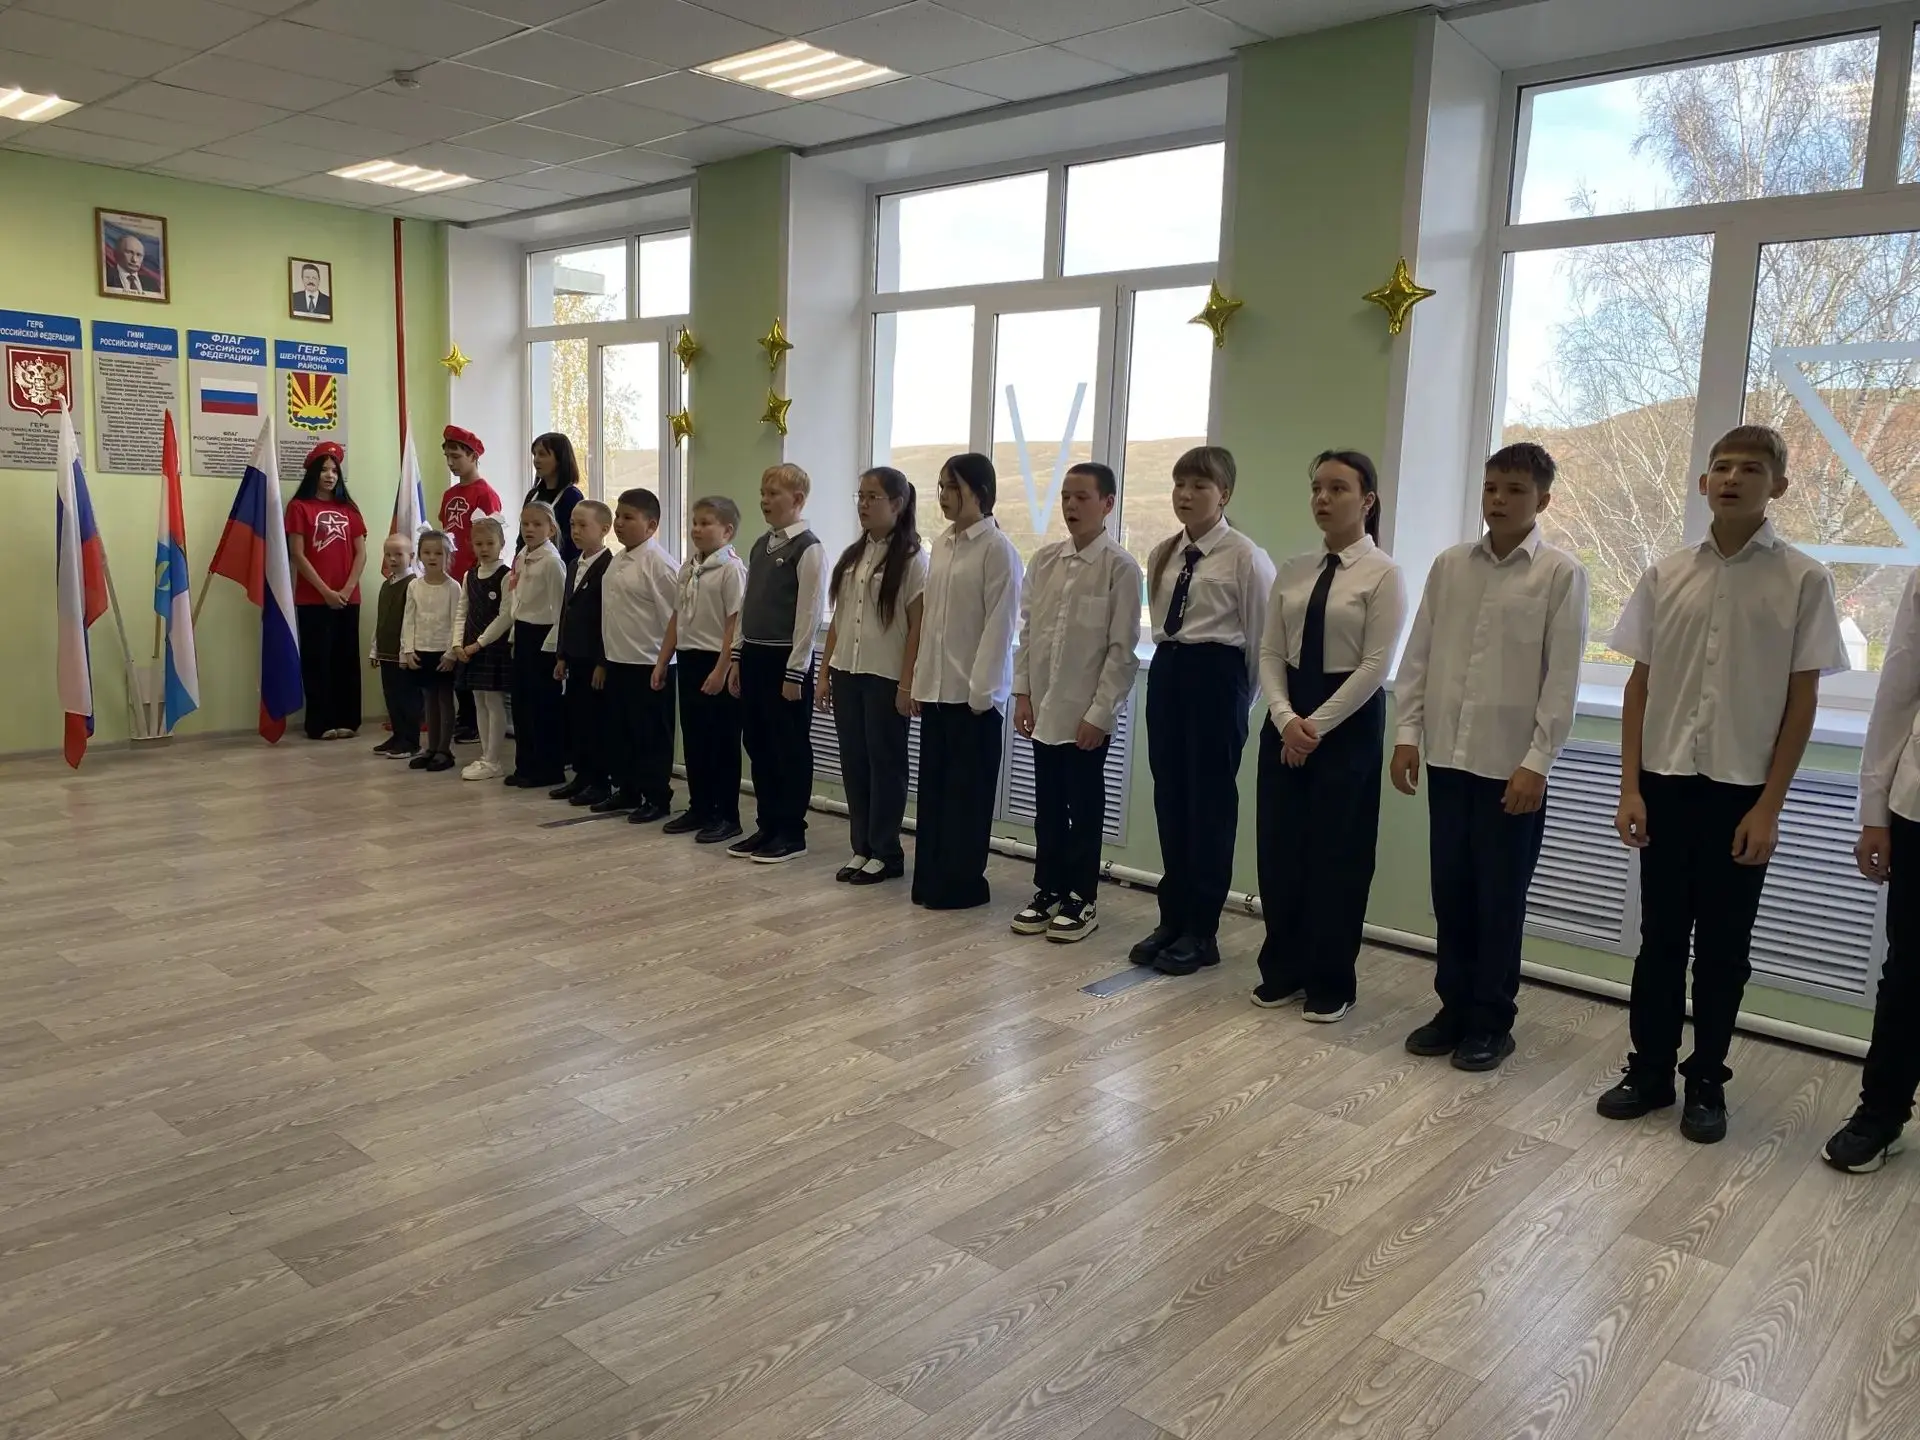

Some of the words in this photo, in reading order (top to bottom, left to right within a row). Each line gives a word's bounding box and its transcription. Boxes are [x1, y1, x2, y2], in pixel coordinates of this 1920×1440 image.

[26, 320, 44, 329] ГЕРБ
[40, 332, 76, 343] ФЕДЕРАЦИИ
[127, 330, 145, 339] ГИМН
[211, 334, 246, 345] ФЛАГ
[100, 337, 139, 349] РОССИЙСКОЙ
[140, 342, 173, 352] ФЕДЕРАЦИИ
[195, 342, 260, 356] РОССИЙСКОЙ
[298, 344, 328, 355] ГЕРБ
[200, 350, 253, 362] ФЕДЕРАЦИИ
[280, 352, 345, 365] ШЕНТАЛИНСКОГО
[297, 361, 328, 371] РАЙОНА
